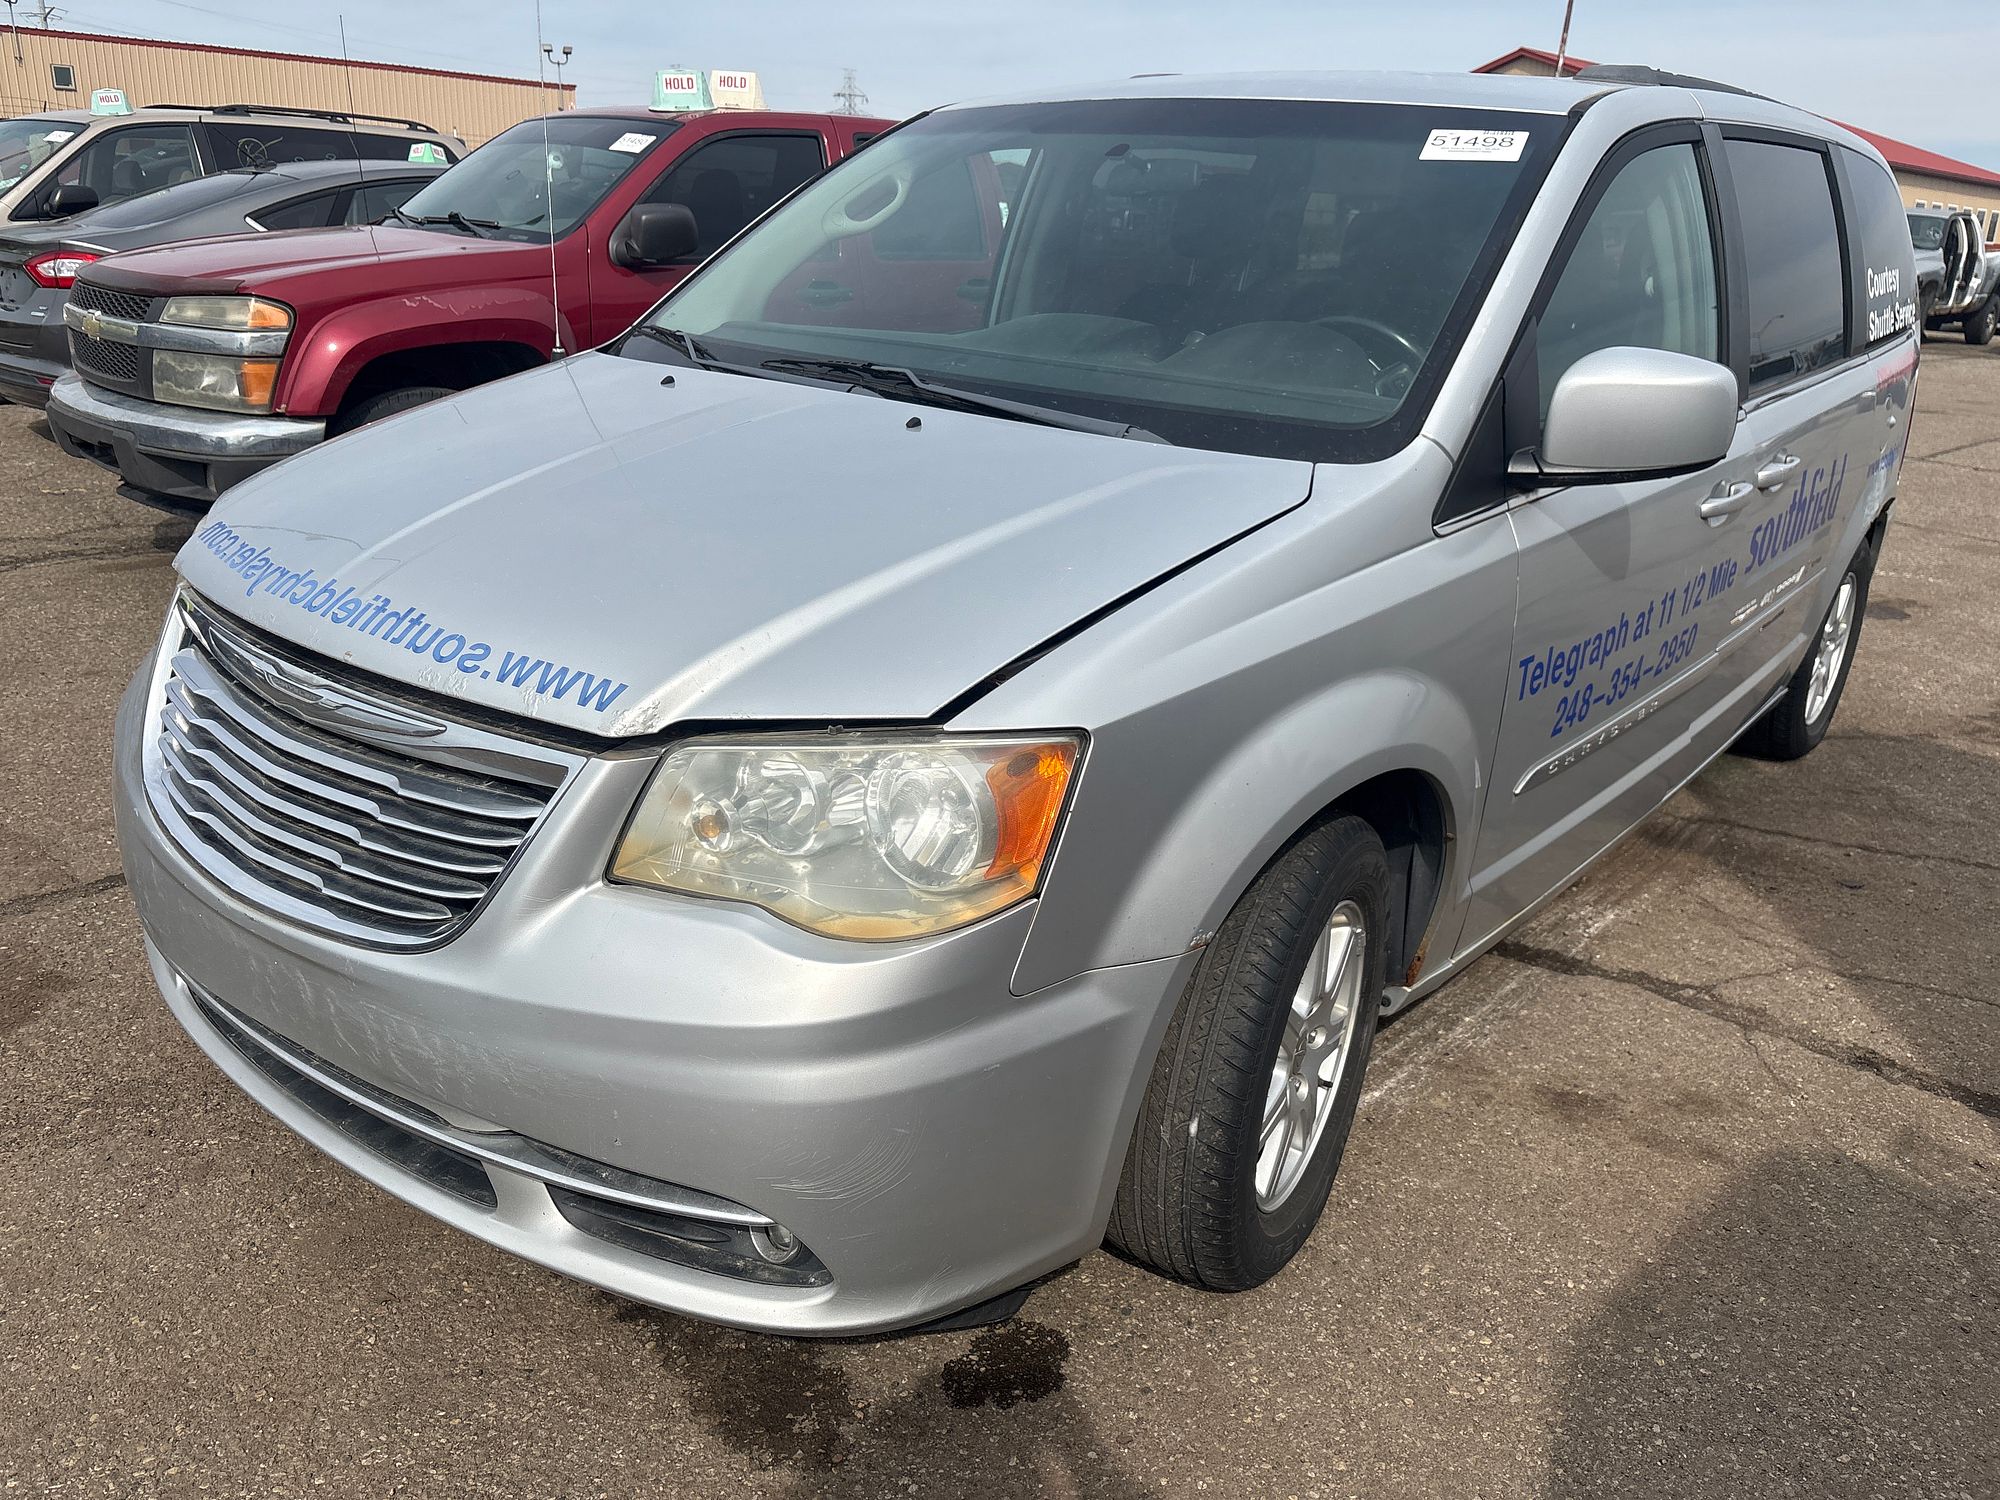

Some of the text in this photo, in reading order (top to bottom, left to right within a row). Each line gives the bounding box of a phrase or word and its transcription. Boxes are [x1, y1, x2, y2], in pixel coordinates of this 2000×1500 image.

[99, 94, 120, 103] HOLD
[664, 77, 694, 90] HOLD
[719, 75, 747, 89] HOLD
[1431, 135, 1515, 148] 51498
[1867, 266, 1900, 299] Courtesy
[1869, 298, 1916, 342] Shuttle Service
[1744, 452, 1848, 575] southfield
[1518, 611, 1630, 702] Telegraph
[1633, 600, 1655, 643] at
[1658, 587, 1677, 630] 11
[1681, 572, 1708, 617] 1/2
[1707, 557, 1738, 601] Mile
[1550, 622, 1699, 738] 248-354-2950
